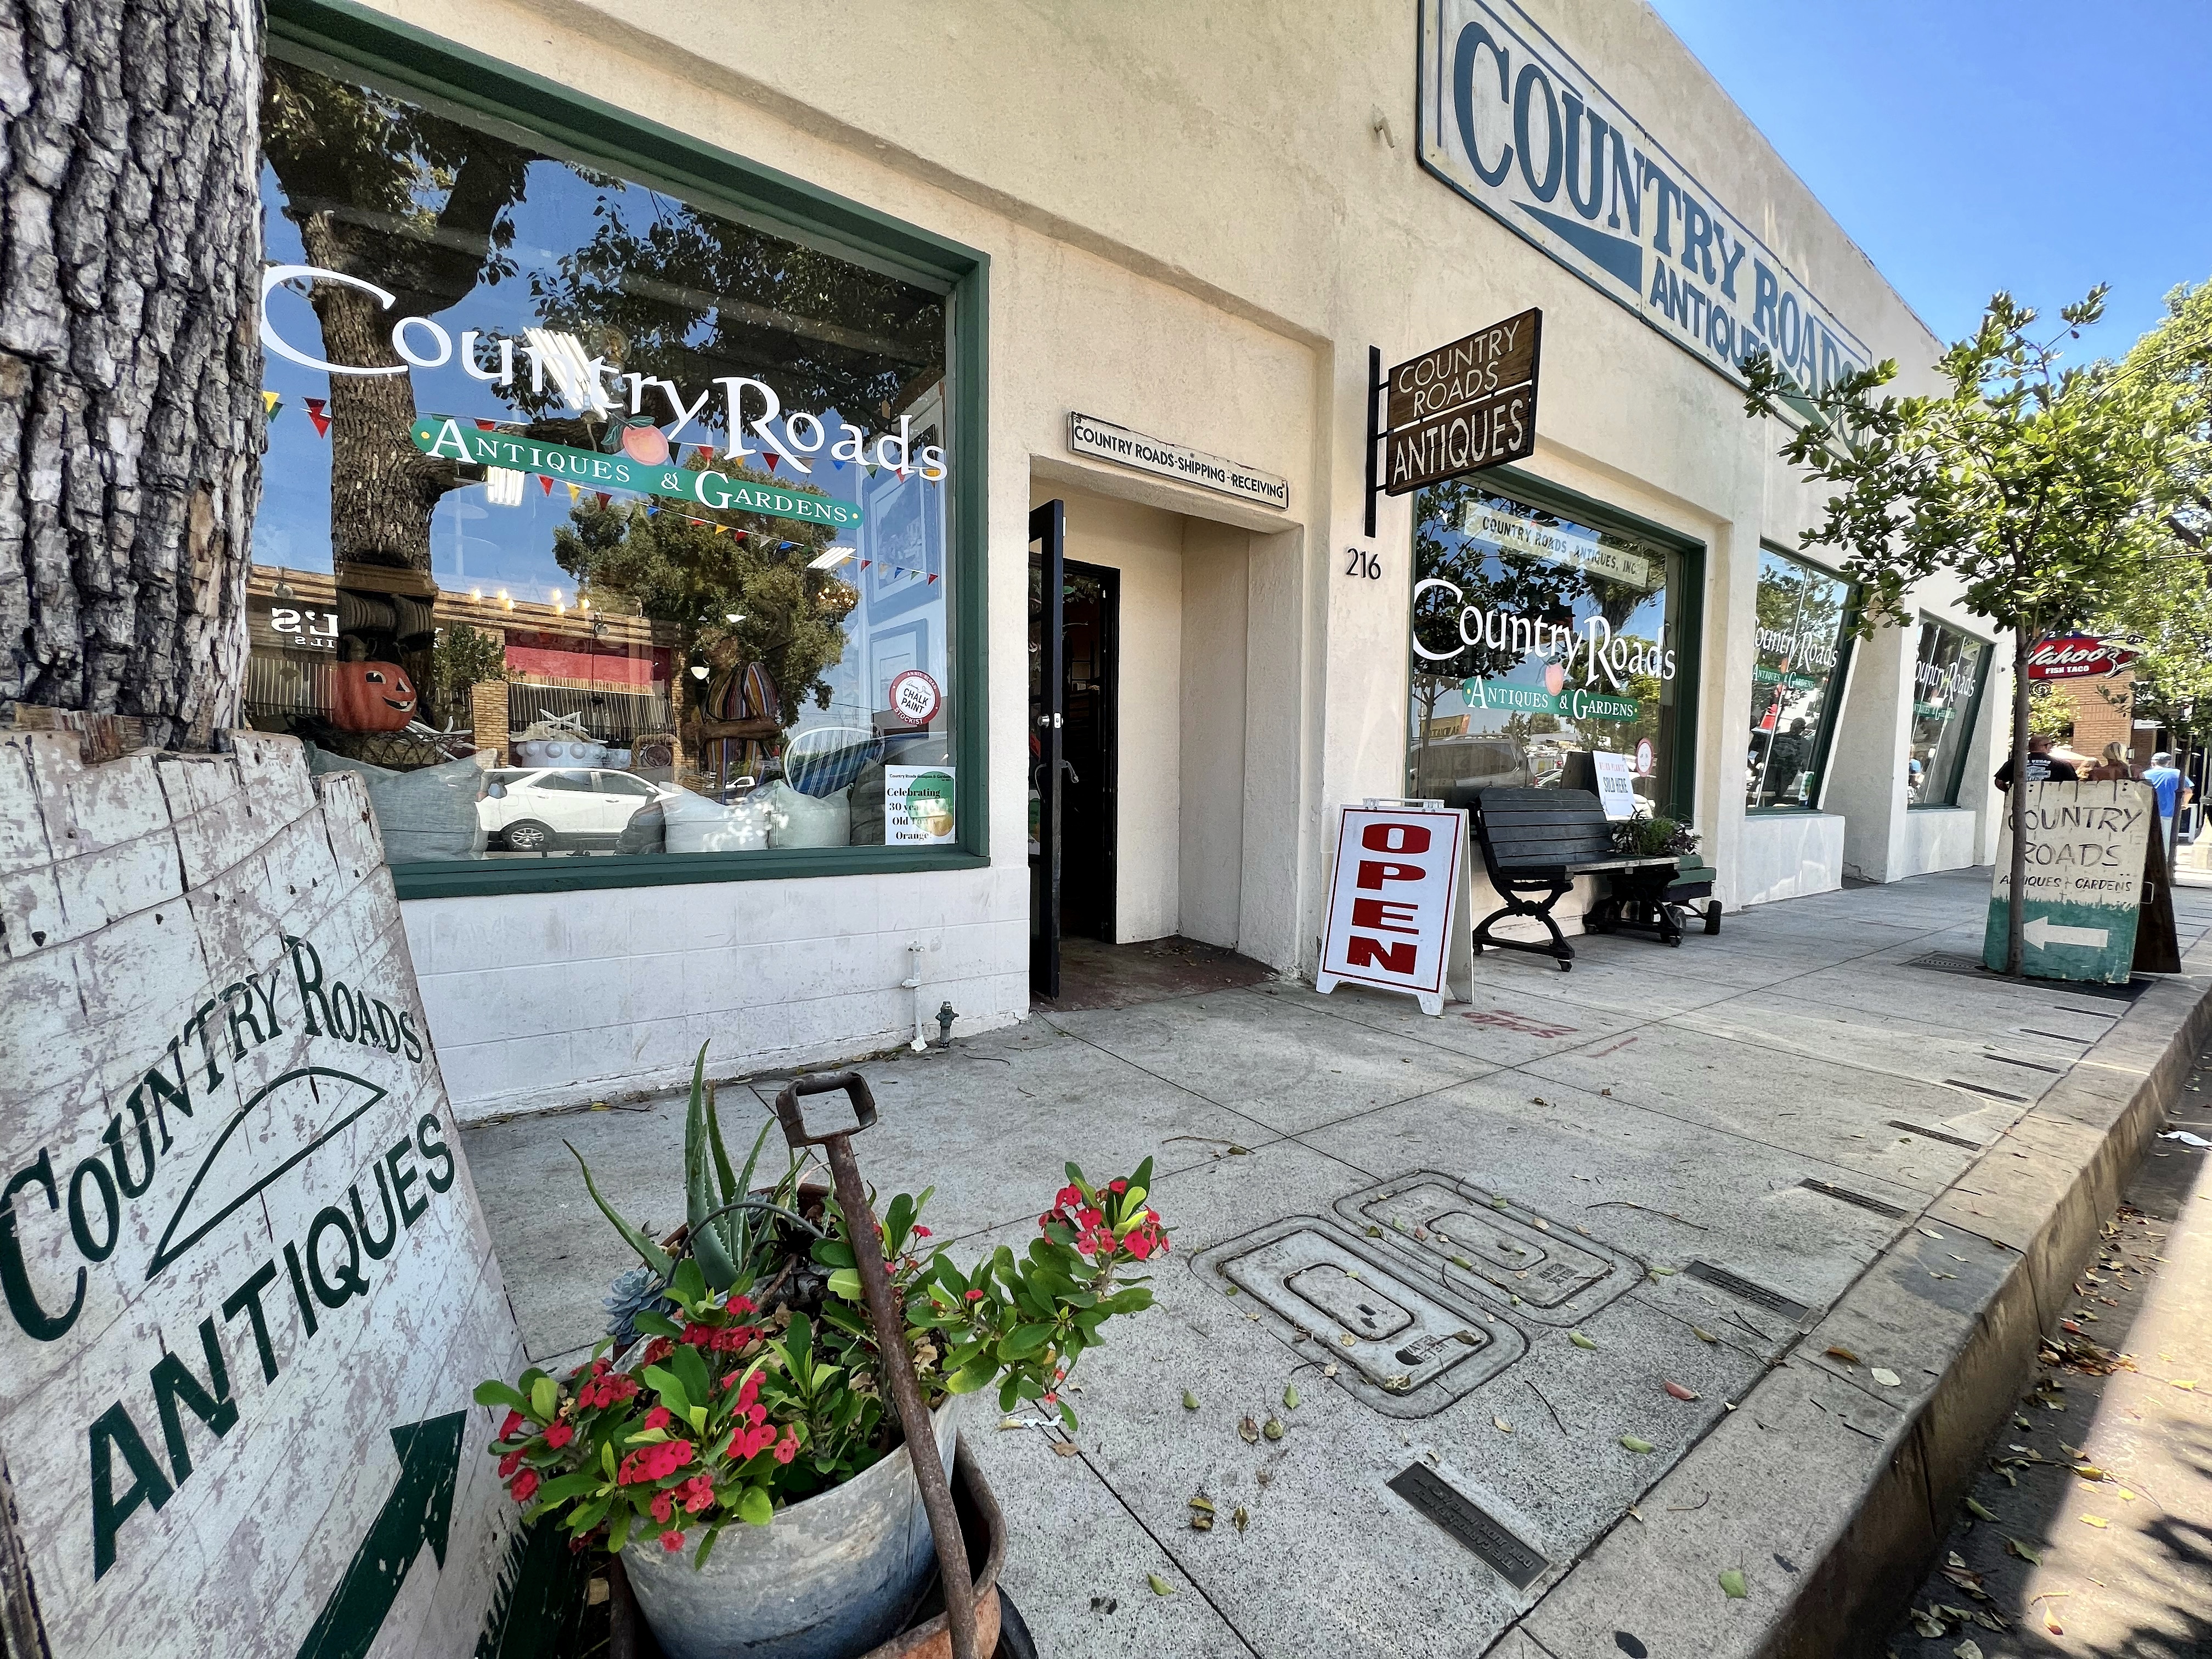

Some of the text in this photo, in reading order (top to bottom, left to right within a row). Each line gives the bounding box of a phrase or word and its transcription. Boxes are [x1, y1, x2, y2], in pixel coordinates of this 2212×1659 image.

[1454, 21, 1746, 302] COUNTRY
[259, 266, 947, 482] Country Roads
[1399, 319, 1520, 393] COUNTRY
[1413, 361, 1499, 417] ROADS
[1075, 426, 1133, 455] COUNTRY
[1393, 399, 1524, 486] ANTIQUES
[425, 418, 848, 523] ANTIQUES & GARDENS
[1482, 516, 1531, 543] COUNTRY
[1536, 532, 1567, 553] ROADS
[1346, 548, 1381, 580] 216
[1414, 578, 1675, 689] Country Roads
[1754, 616, 1838, 672] ountry Roads
[904, 688, 929, 706] CHALK
[1468, 675, 1633, 720] ANTIQUES & GARDENS
[1915, 655, 1948, 697] ountry
[894, 707, 923, 724] STOCKIST
[901, 697, 925, 713] PAINT
[887, 788, 941, 798] Celebrating
[889, 802, 902, 811] 30
[892, 816, 909, 825] Old
[2008, 806, 2143, 832] OUNTRY
[1346, 823, 1431, 975] OPEN
[2000, 874, 2062, 888] AIQUES
[0, 934, 424, 1342] COUNTRY ROADS
[89, 1113, 456, 1583] ANTIQUES
